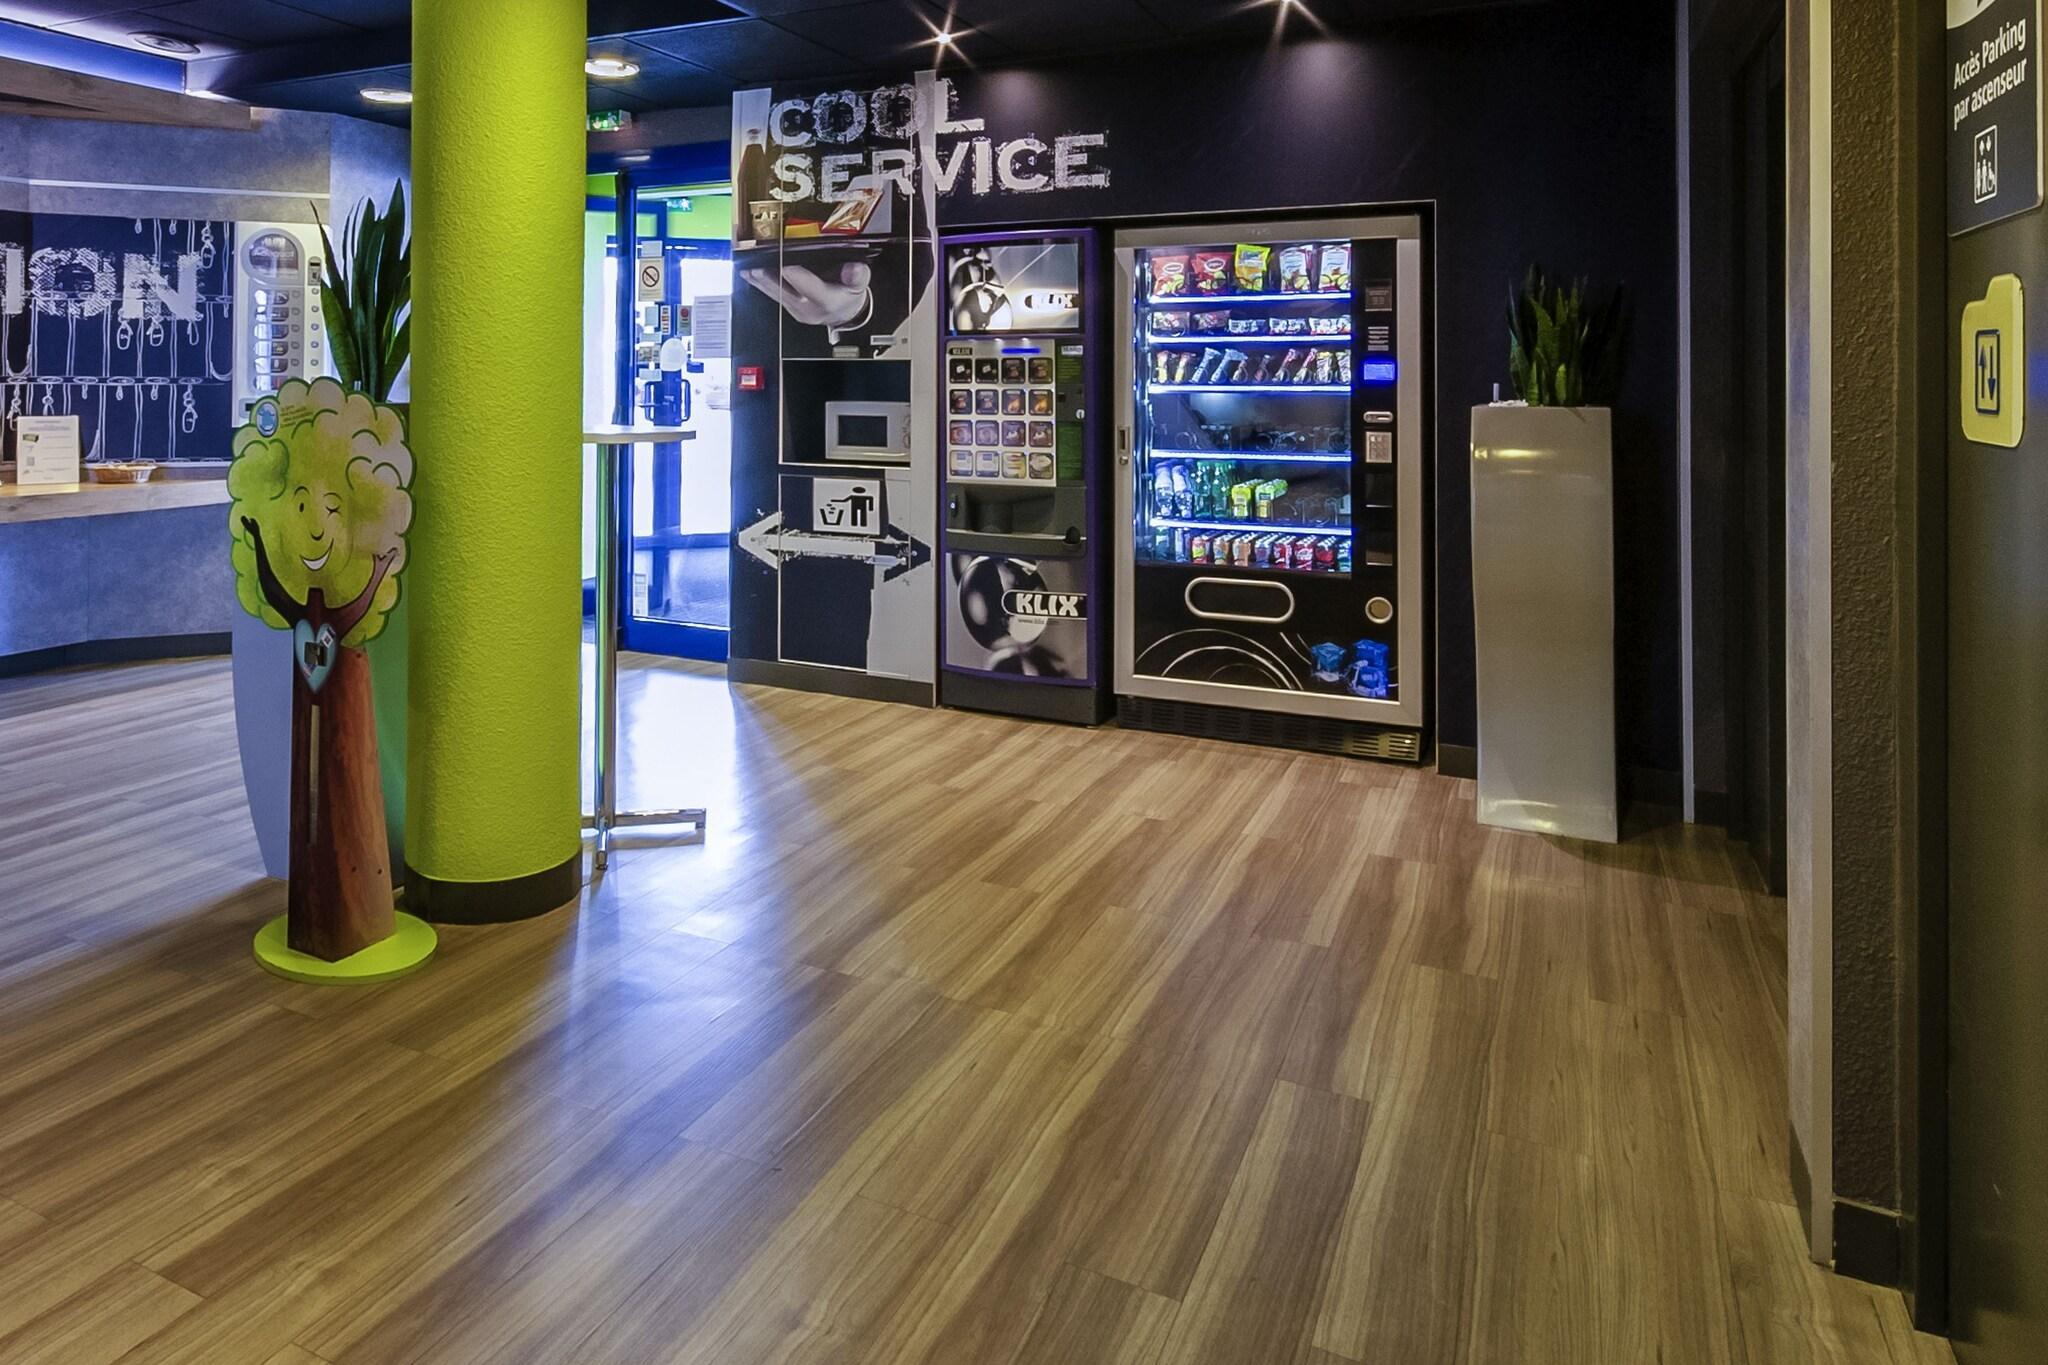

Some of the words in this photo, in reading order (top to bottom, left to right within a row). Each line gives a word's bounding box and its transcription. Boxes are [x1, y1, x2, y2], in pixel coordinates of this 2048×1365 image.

[1953, 50, 1980, 90] Accès
[1982, 18, 2026, 69] Parking
[769, 78, 985, 149] COOL
[1953, 96, 1970, 131] par
[1971, 57, 2027, 113] ascenseur
[769, 131, 1111, 202] SERVICE
[1015, 592, 1079, 617] KLIX
